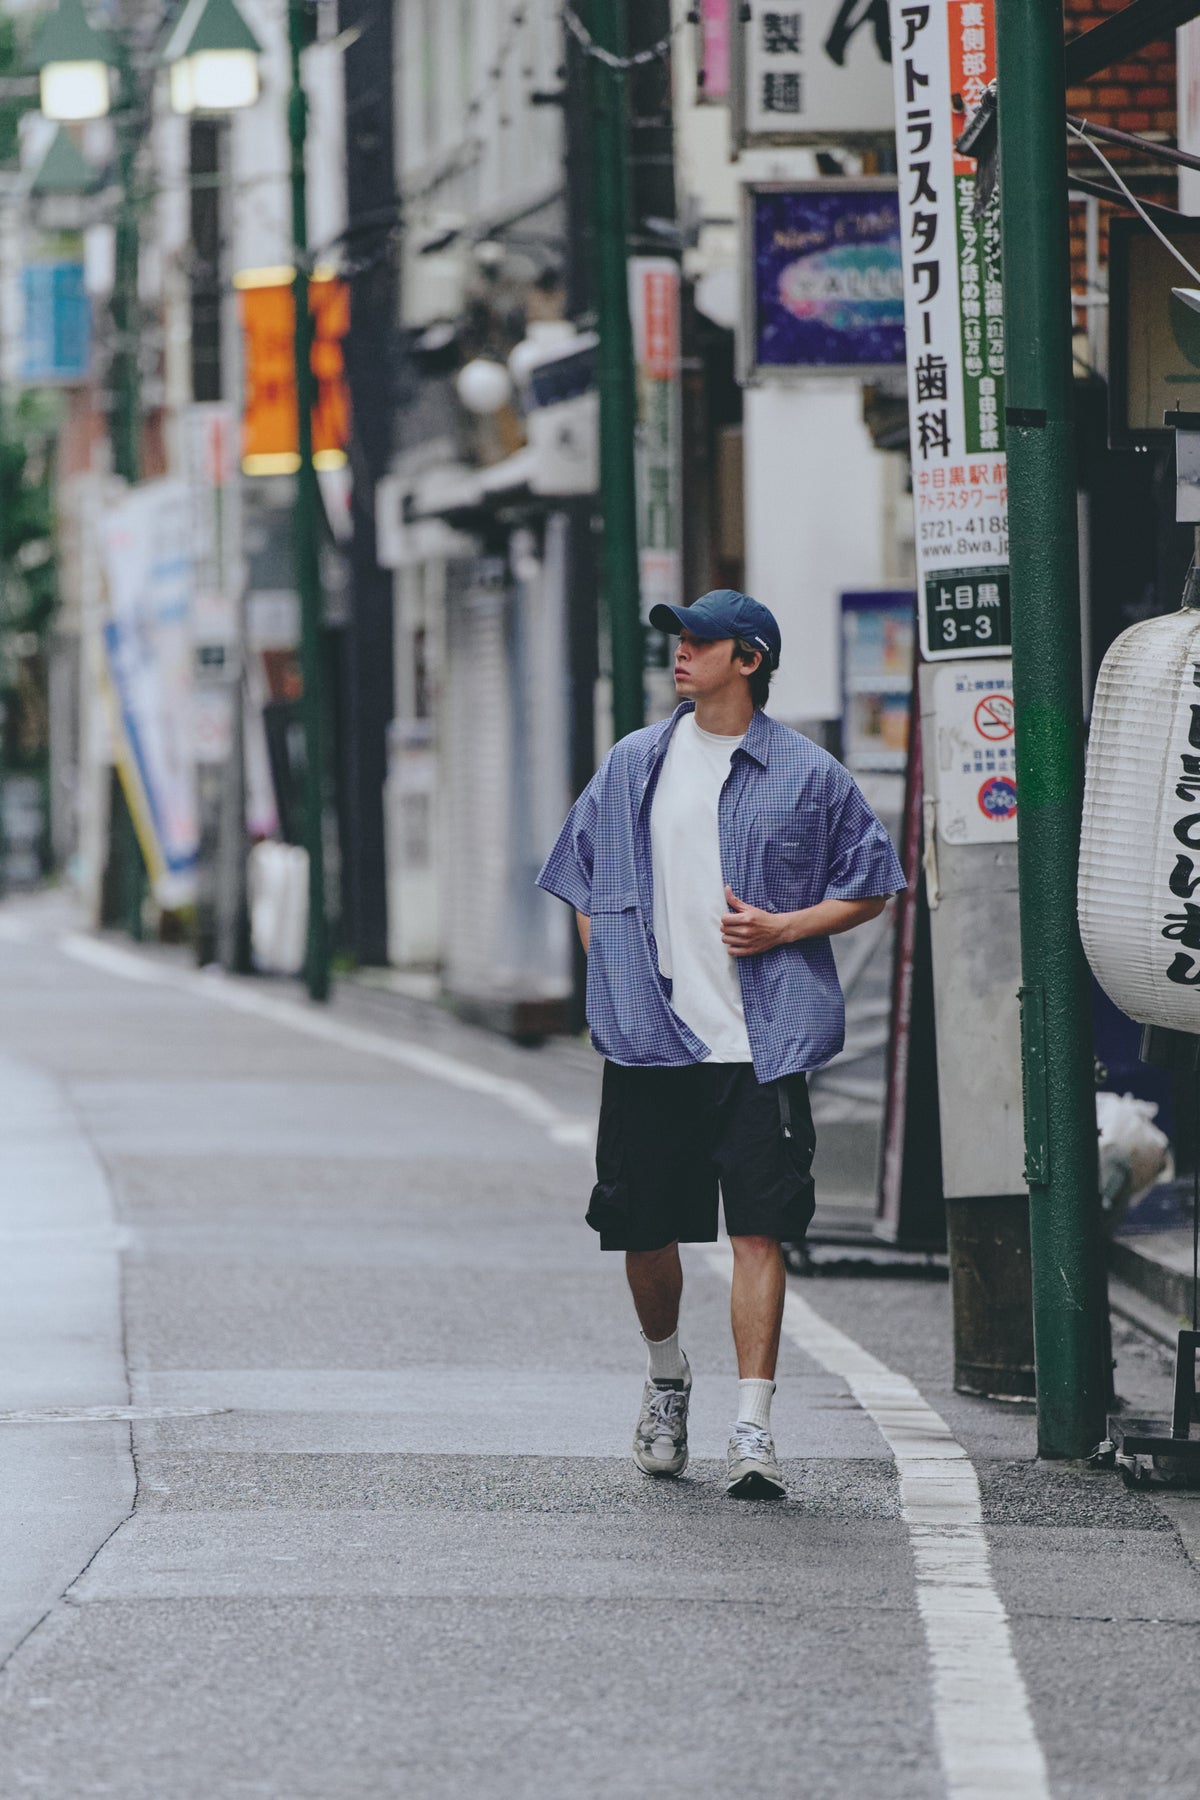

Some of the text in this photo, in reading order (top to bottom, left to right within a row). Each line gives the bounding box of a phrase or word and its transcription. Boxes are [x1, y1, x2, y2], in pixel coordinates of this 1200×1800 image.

[960, 3, 988, 124] 裏側部分
[901, 5, 951, 460] アトラスタワー歯科
[935, 583, 1000, 612] 上目黒
[942, 615, 992, 642] 3-3
